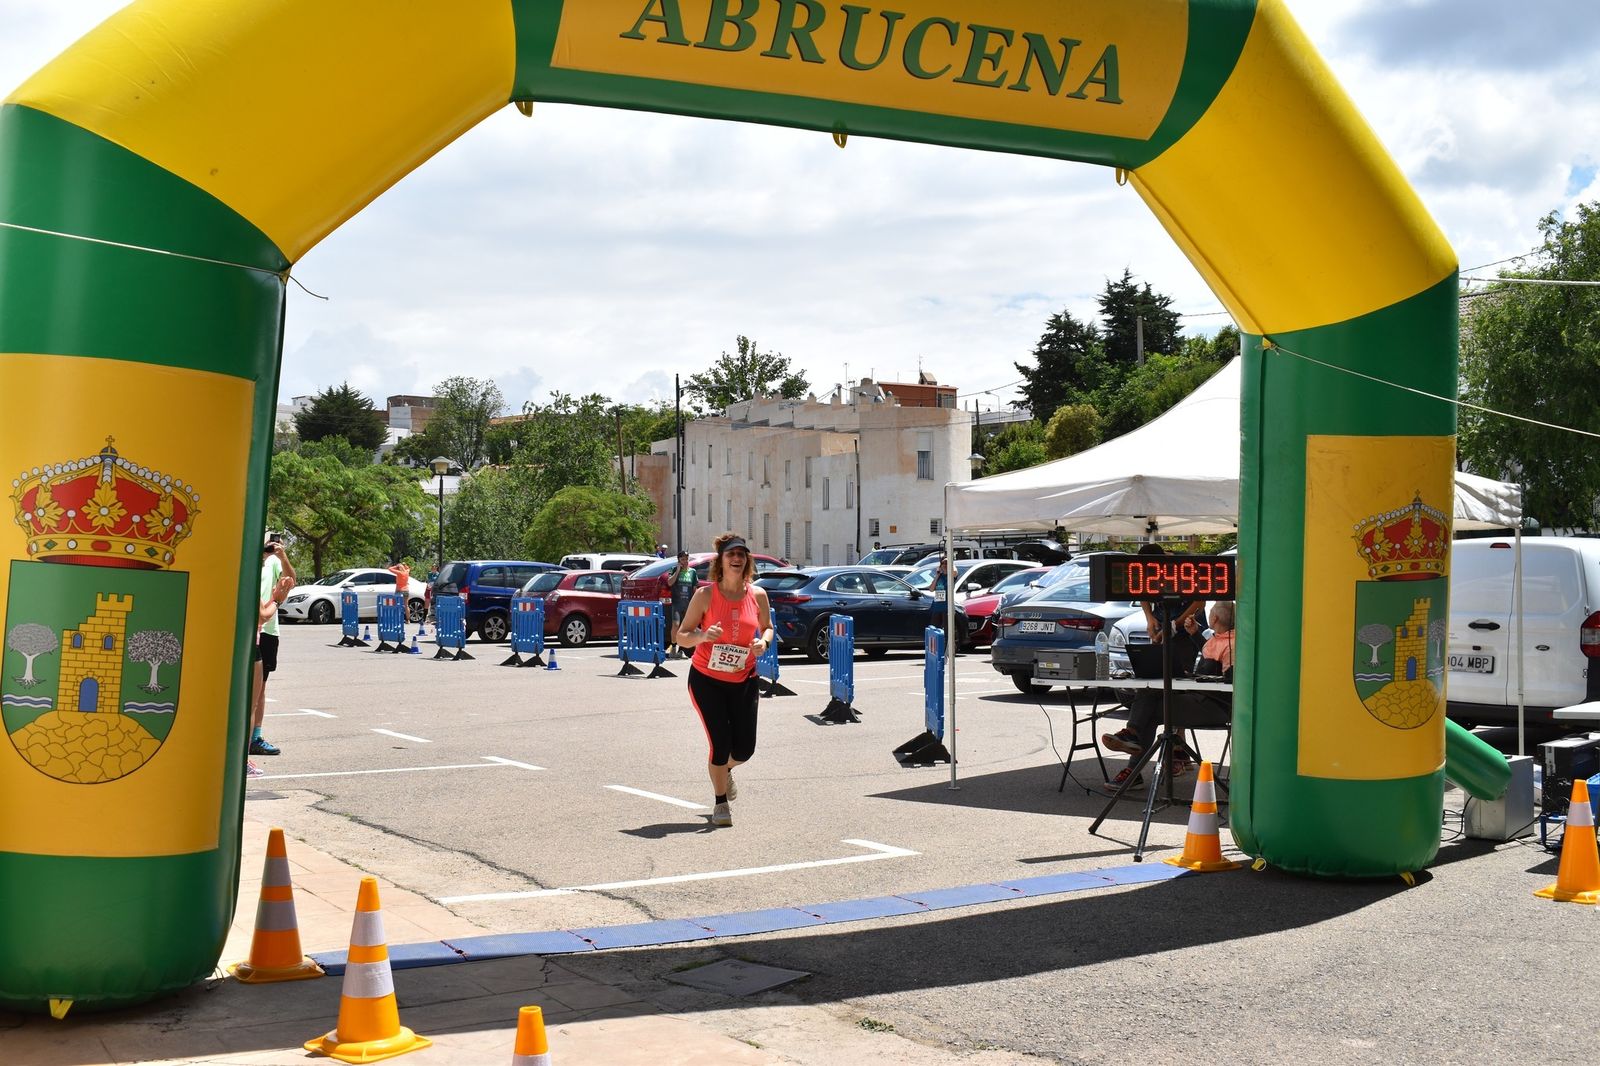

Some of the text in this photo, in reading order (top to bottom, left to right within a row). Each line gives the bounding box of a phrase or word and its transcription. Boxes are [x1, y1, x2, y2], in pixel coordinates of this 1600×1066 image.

[619, 0, 1123, 104] ABRUCENA
[1128, 562, 1228, 594] 02:49:33
[719, 652, 741, 664] 557
[1448, 656, 1489, 669] 04 MBP
